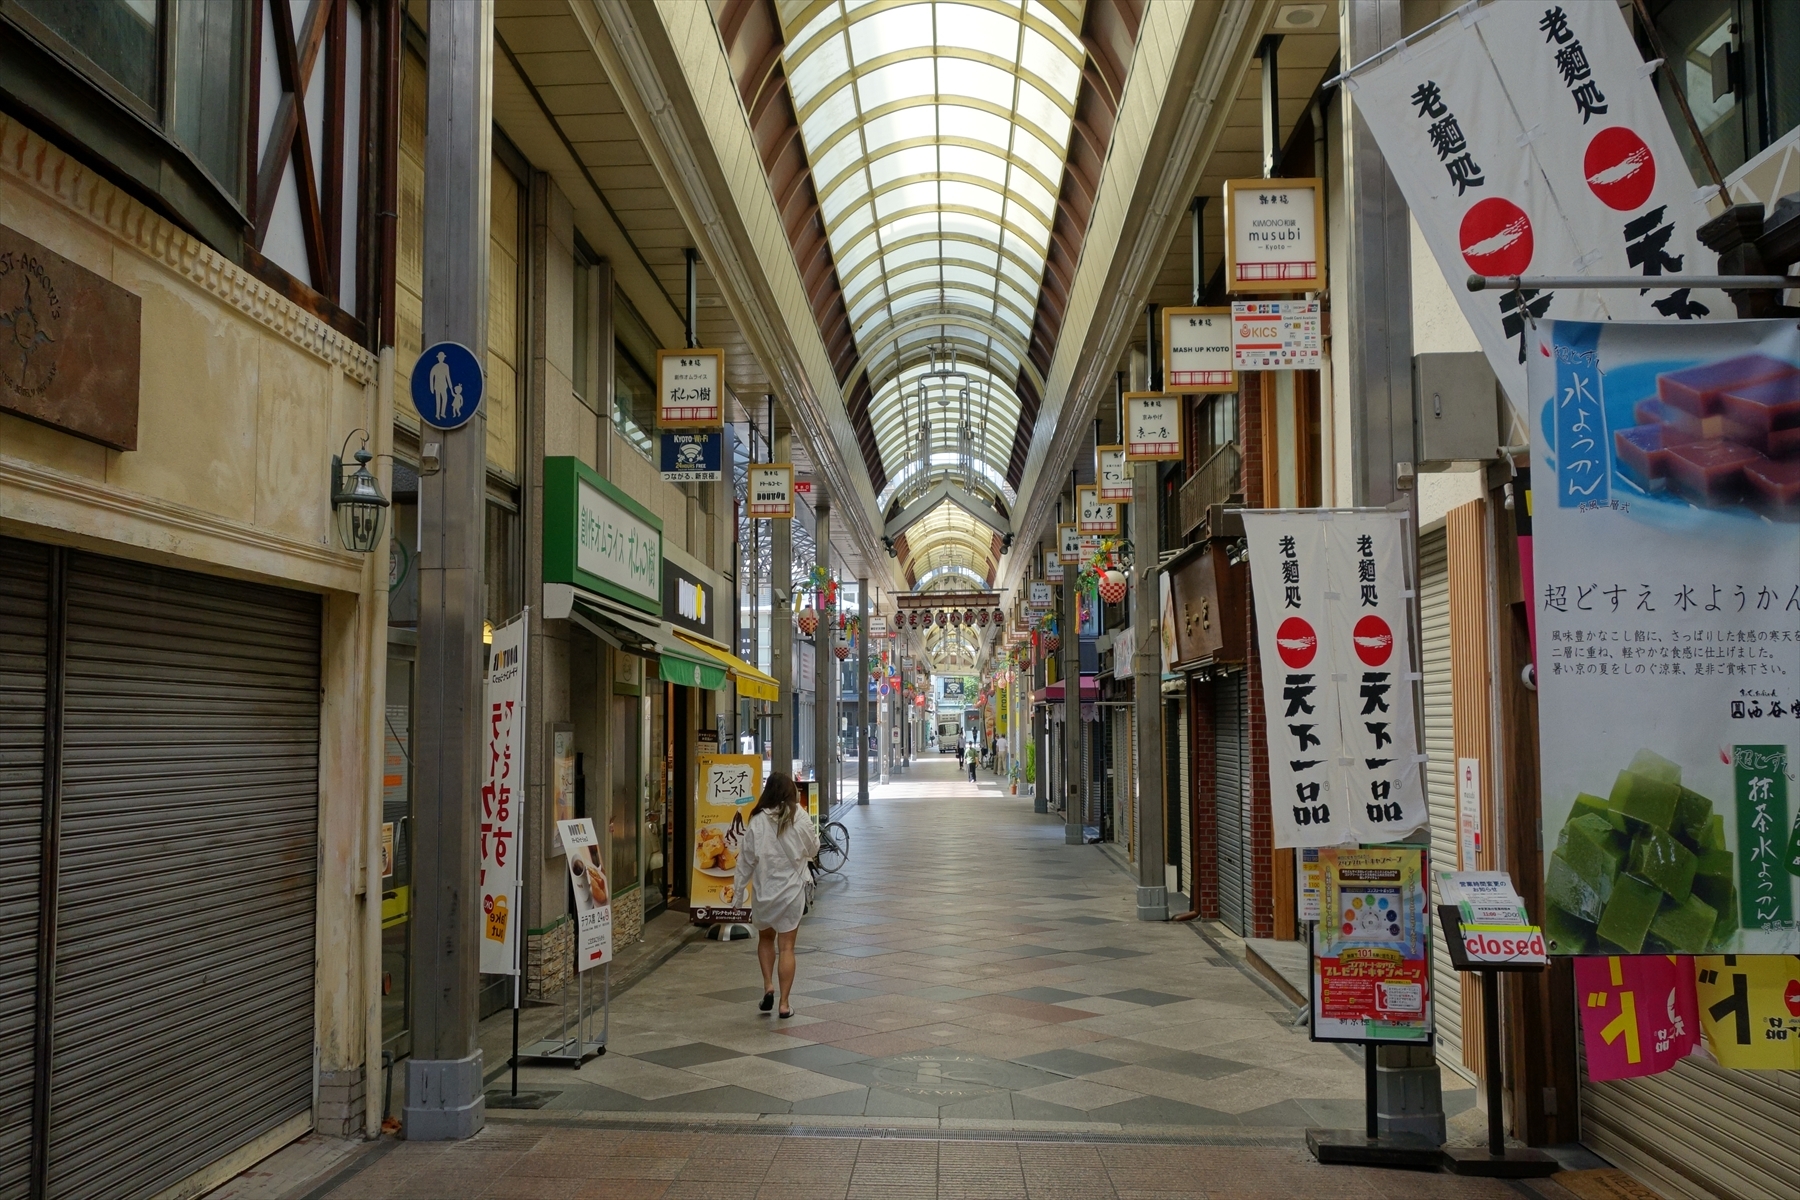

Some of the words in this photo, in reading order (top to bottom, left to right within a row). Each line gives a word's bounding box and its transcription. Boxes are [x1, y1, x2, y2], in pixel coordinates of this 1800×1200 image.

[1252, 219, 1284, 227] KIMONO
[1248, 227, 1301, 241] musubi
[1252, 327, 1278, 338] KICS
[673, 434, 693, 443] KYOTO
[1561, 371, 1605, 496] 水ようかん
[664, 472, 719, 480] つながる、新京極。
[756, 491, 786, 501] DOUTOR
[1579, 499, 1631, 514] 京風二層式
[581, 504, 625, 565] 創作オムライス
[1543, 582, 1657, 612] 超どすえ
[1673, 583, 1800, 613] 水ようかん
[1551, 646, 1775, 660] 二層に重ね、軽やかな食感に仕上げました。
[1283, 673, 1331, 826] 天下一品
[1360, 671, 1404, 823] 天下一品
[713, 771, 748, 785] フレンチ
[715, 784, 746, 798] トースト
[1748, 776, 1780, 920] 抹茶水ようかん
[1466, 934, 1545, 956] closed
[1324, 966, 1421, 978] プレゼントキャンペーン
